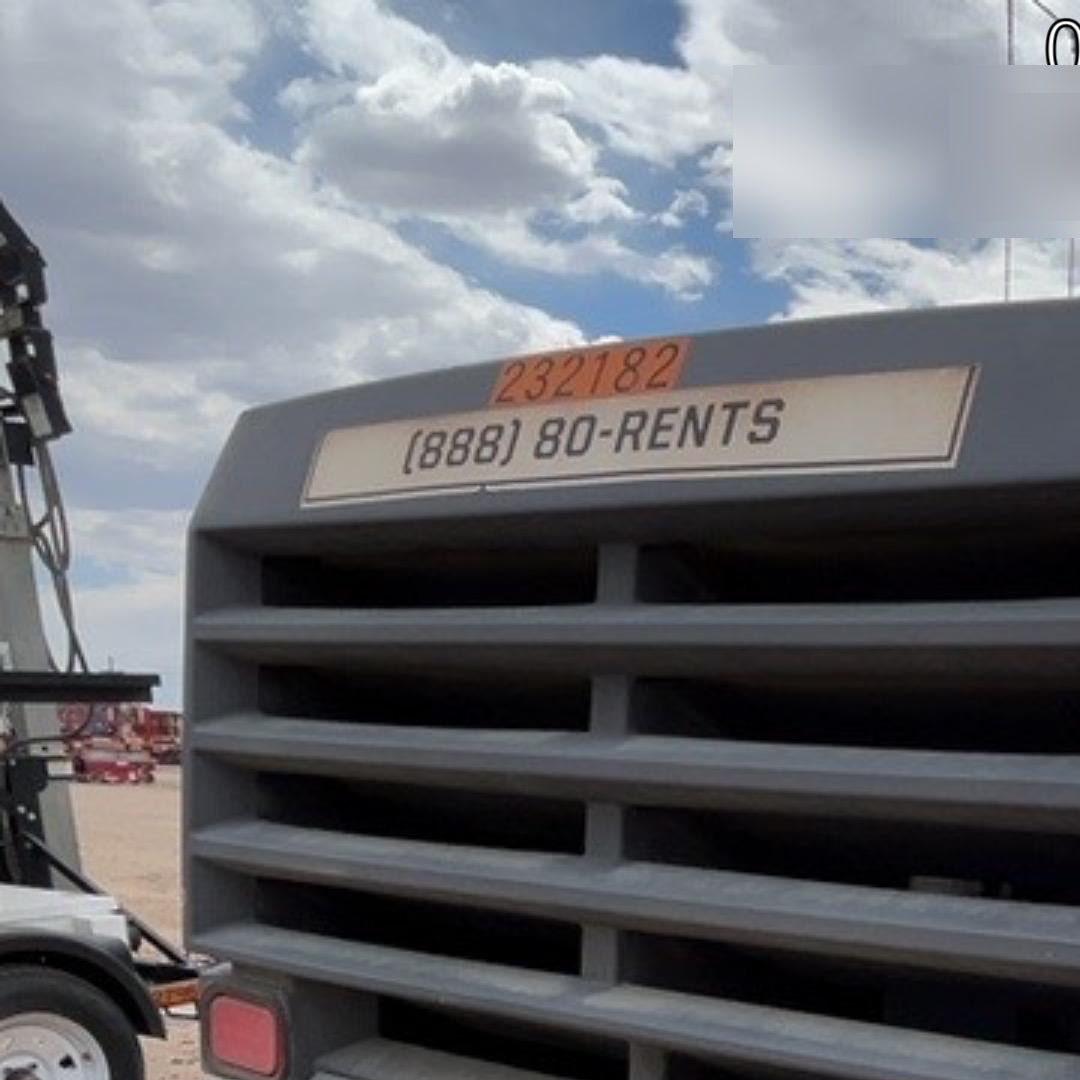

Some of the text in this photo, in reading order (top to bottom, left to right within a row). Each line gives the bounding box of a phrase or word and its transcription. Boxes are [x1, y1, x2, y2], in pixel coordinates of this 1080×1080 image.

[496, 344, 680, 402] 232182
[403, 398, 785, 474] (888) 80-RENTS
